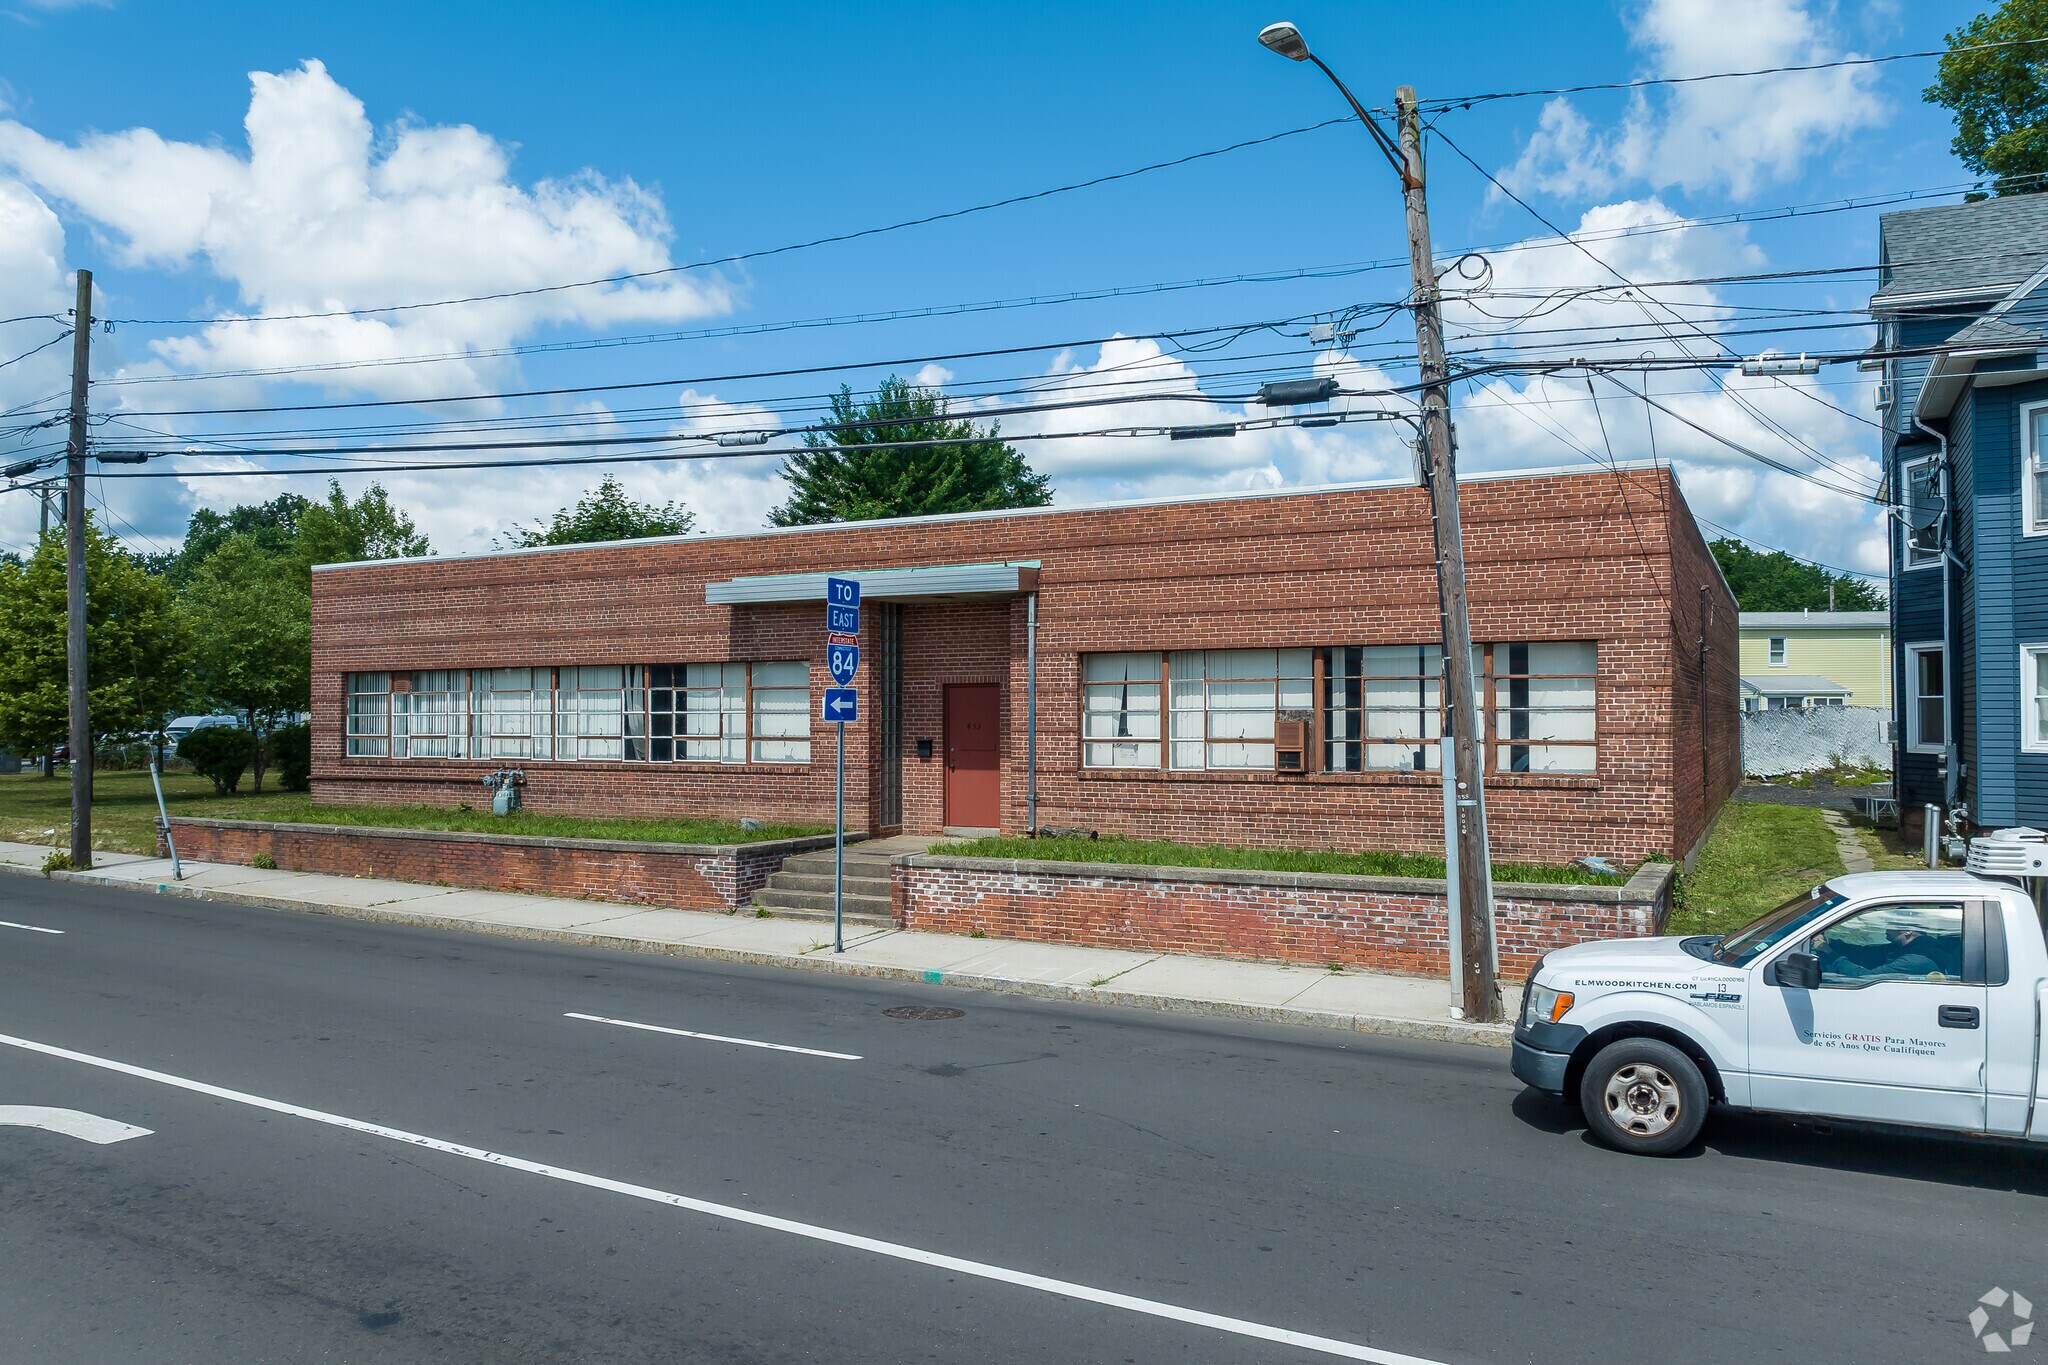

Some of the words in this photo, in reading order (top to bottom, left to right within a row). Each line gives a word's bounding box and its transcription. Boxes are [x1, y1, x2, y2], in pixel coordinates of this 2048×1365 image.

[836, 584, 852, 601] TO
[833, 610, 854, 628] EAST
[832, 651, 854, 676] 84
[1575, 979, 1697, 990] ELMWOODKITCHEN.COM
[1717, 983, 1727, 993] 13
[1803, 1030, 1842, 1040] Servicios
[1844, 1033, 1881, 1043] GRATIS
[1885, 1036, 1905, 1045] Para
[1909, 1038, 1947, 1048] Mayores
[1825, 1040, 1836, 1048] 65
[1838, 1042, 1860, 1050] Anos
[1863, 1043, 1881, 1052] Que
[1883, 1044, 1936, 1056] Cualifiquen
